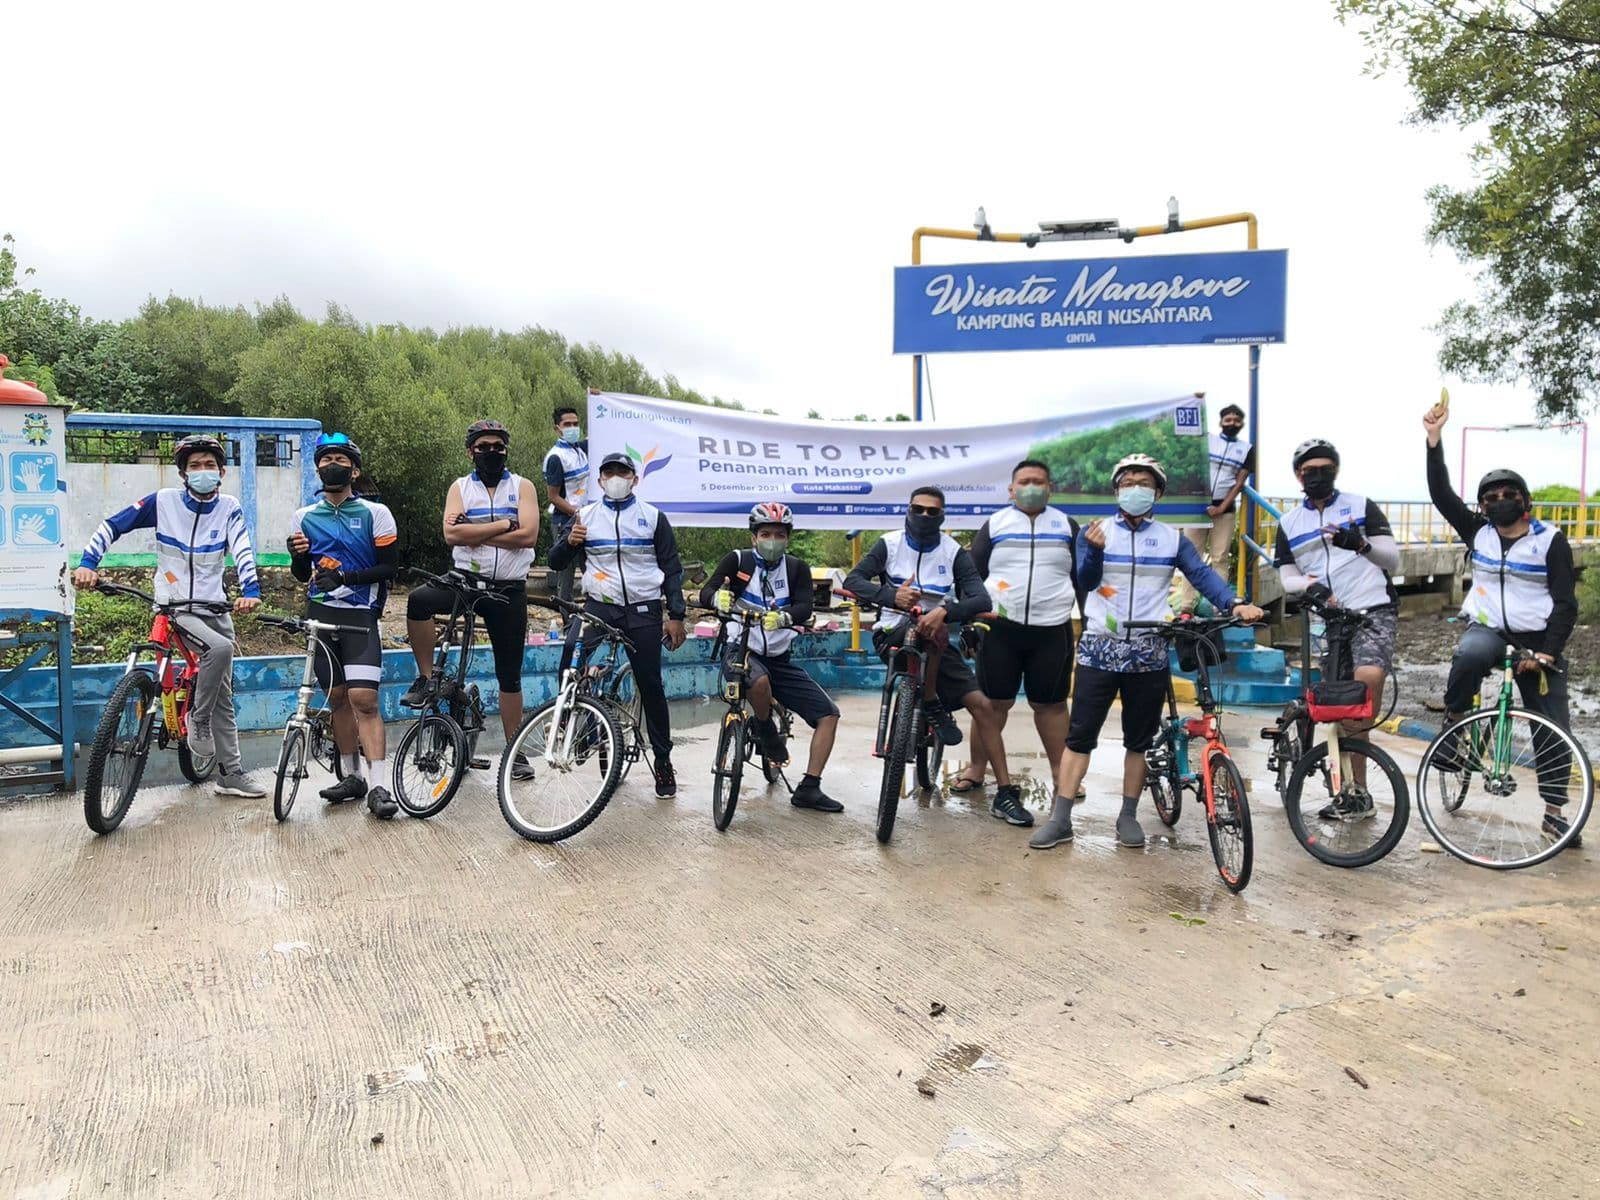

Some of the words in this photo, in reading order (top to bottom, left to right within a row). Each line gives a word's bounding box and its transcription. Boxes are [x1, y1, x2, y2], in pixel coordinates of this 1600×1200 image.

[926, 273, 1057, 316] Wisata
[1062, 265, 1251, 309] Mangrove
[956, 313, 1035, 331] KAMPUNG
[1040, 309, 1103, 328] BAHARI
[1108, 305, 1213, 325] NUSANTARA
[1066, 332, 1096, 344] CINTIA
[610, 407, 692, 425] lindungihutan
[1178, 408, 1199, 425] BFI
[698, 436, 781, 460] RIDE
[796, 444, 842, 461] TO
[859, 444, 971, 461] PLANT
[699, 458, 808, 477] Penanaman
[815, 465, 906, 479] Mangrove
[701, 483, 706, 491] 5
[709, 483, 755, 492] Desember
[758, 484, 779, 492] 2021
